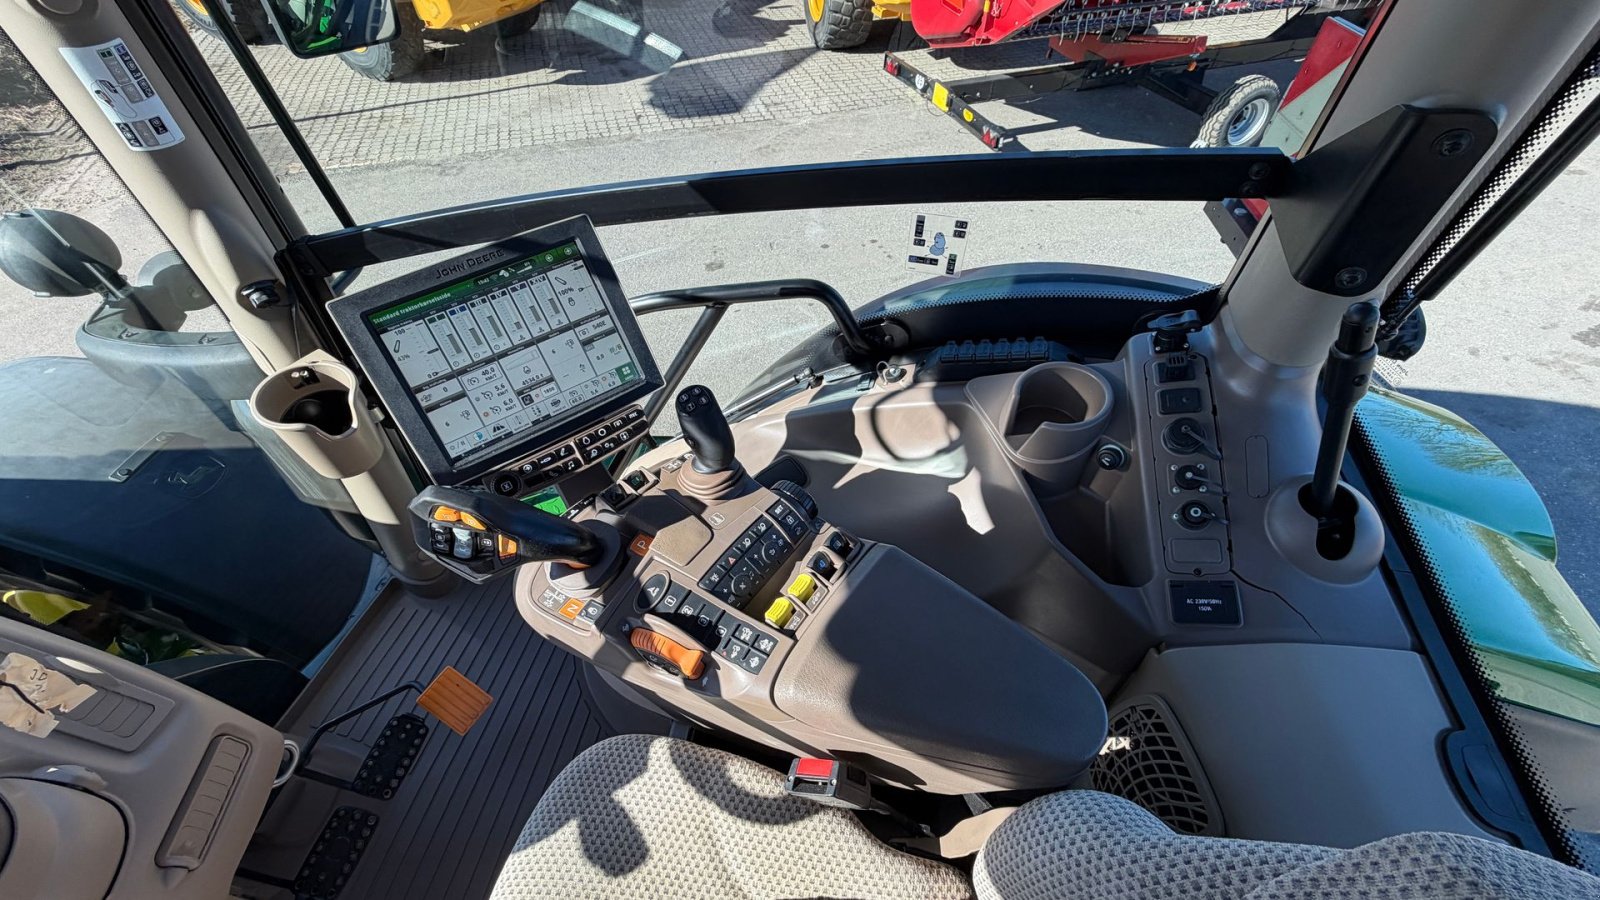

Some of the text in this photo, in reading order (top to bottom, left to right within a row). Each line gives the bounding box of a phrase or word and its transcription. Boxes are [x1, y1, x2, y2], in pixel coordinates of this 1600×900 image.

[435, 249, 505, 280] JOHN DEERE
[557, 286, 575, 297] 100%
[373, 308, 400, 325] Standard
[393, 328, 406, 337] 100
[774, 504, 784, 515] SET
[636, 539, 648, 550] P
[567, 603, 580, 614] N
